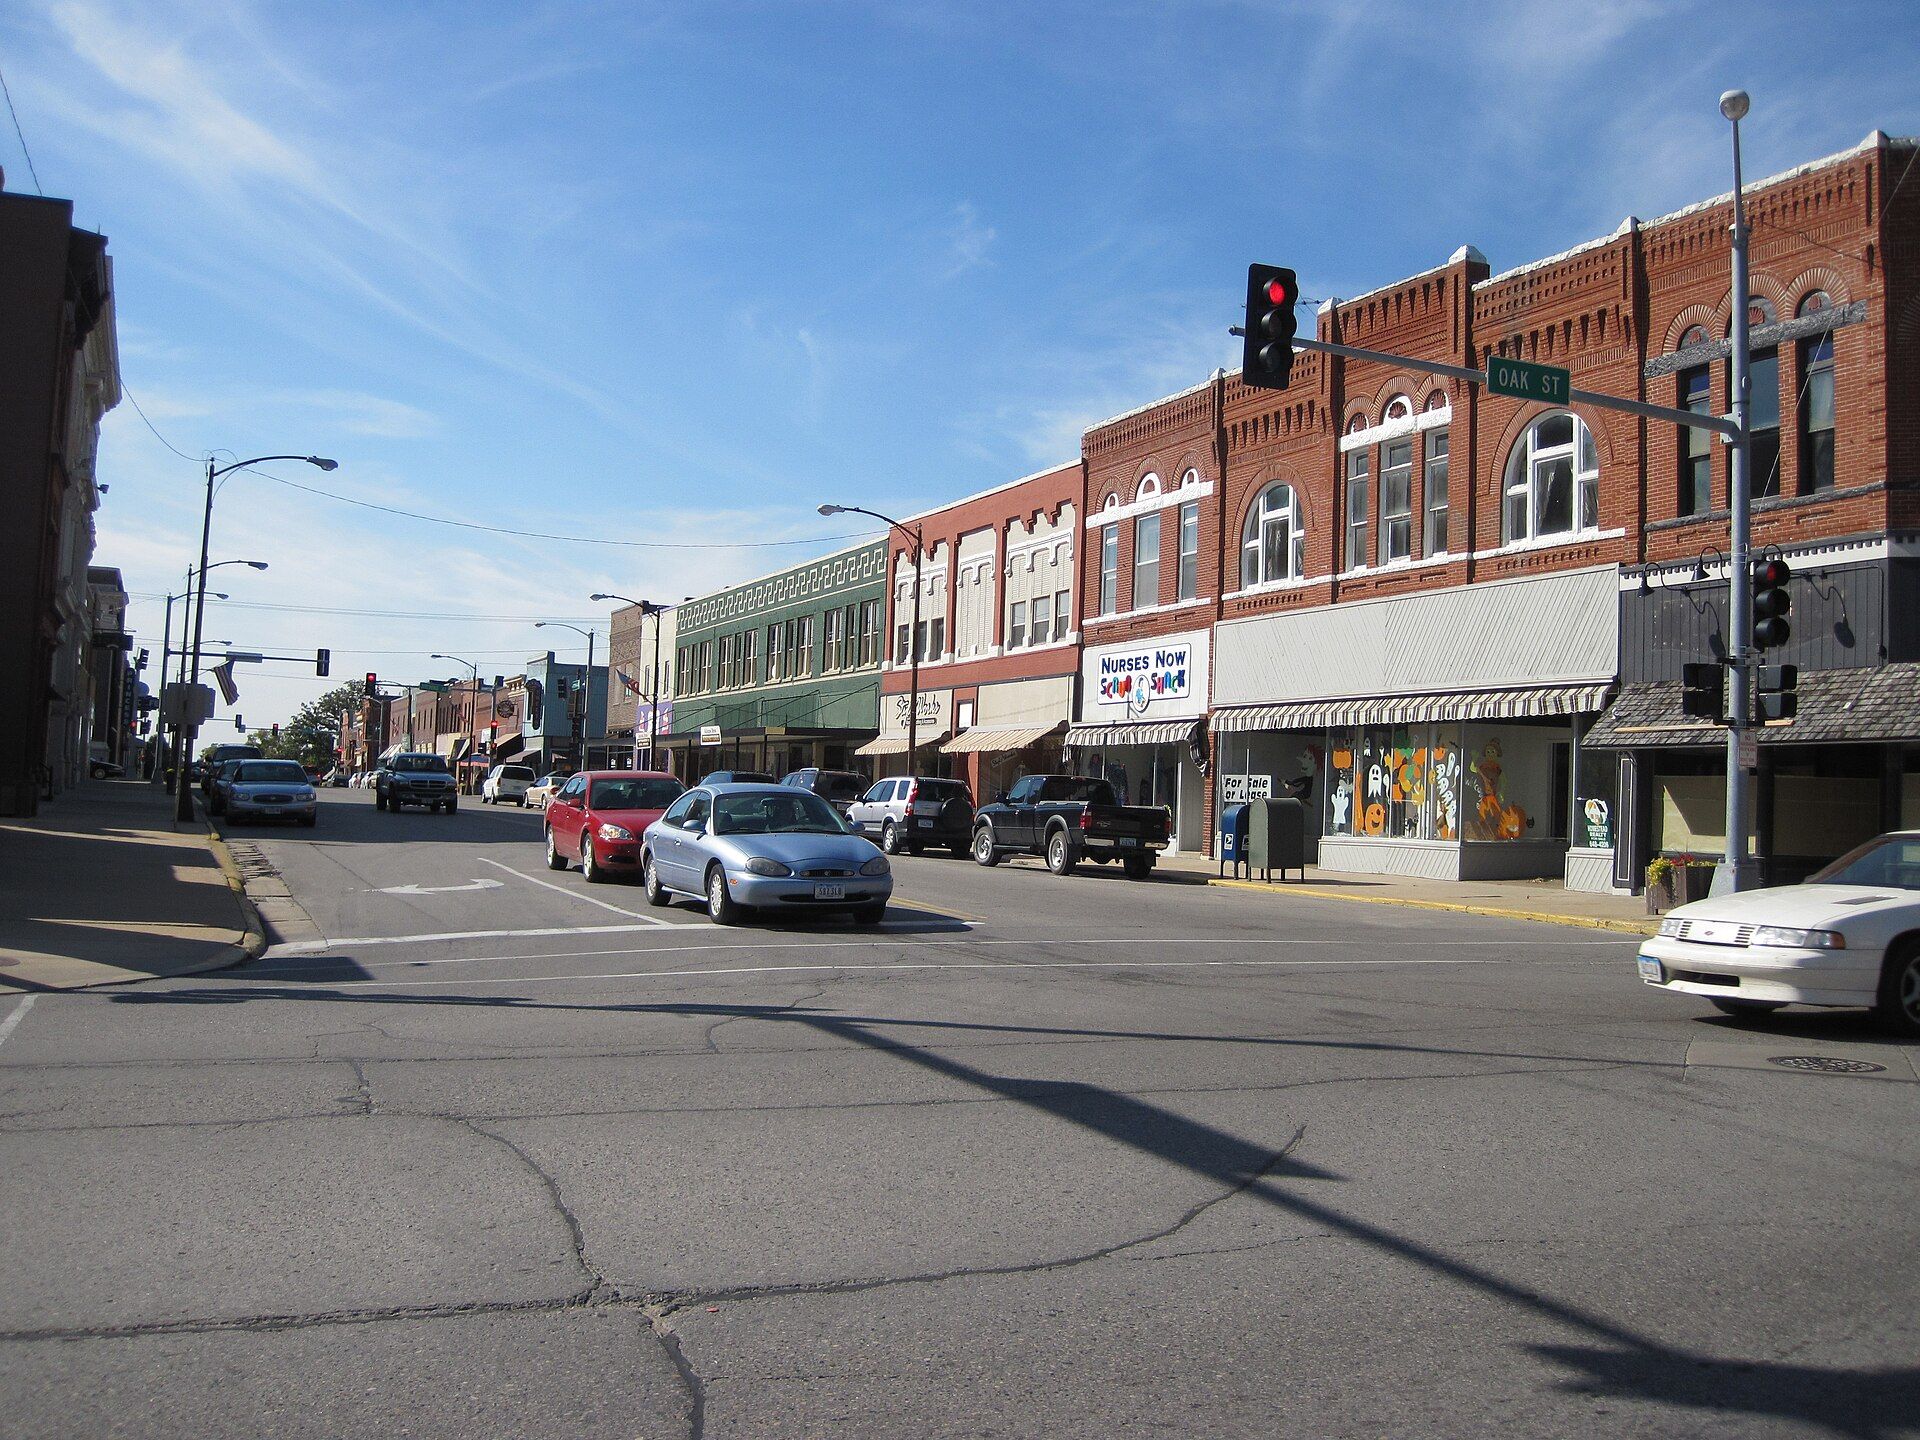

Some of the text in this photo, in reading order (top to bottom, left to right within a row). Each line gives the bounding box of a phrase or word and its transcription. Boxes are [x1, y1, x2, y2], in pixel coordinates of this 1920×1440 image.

[1499, 368, 1560, 395] OAK ST
[1225, 777, 1242, 788] For
[1225, 790, 1236, 800] or
